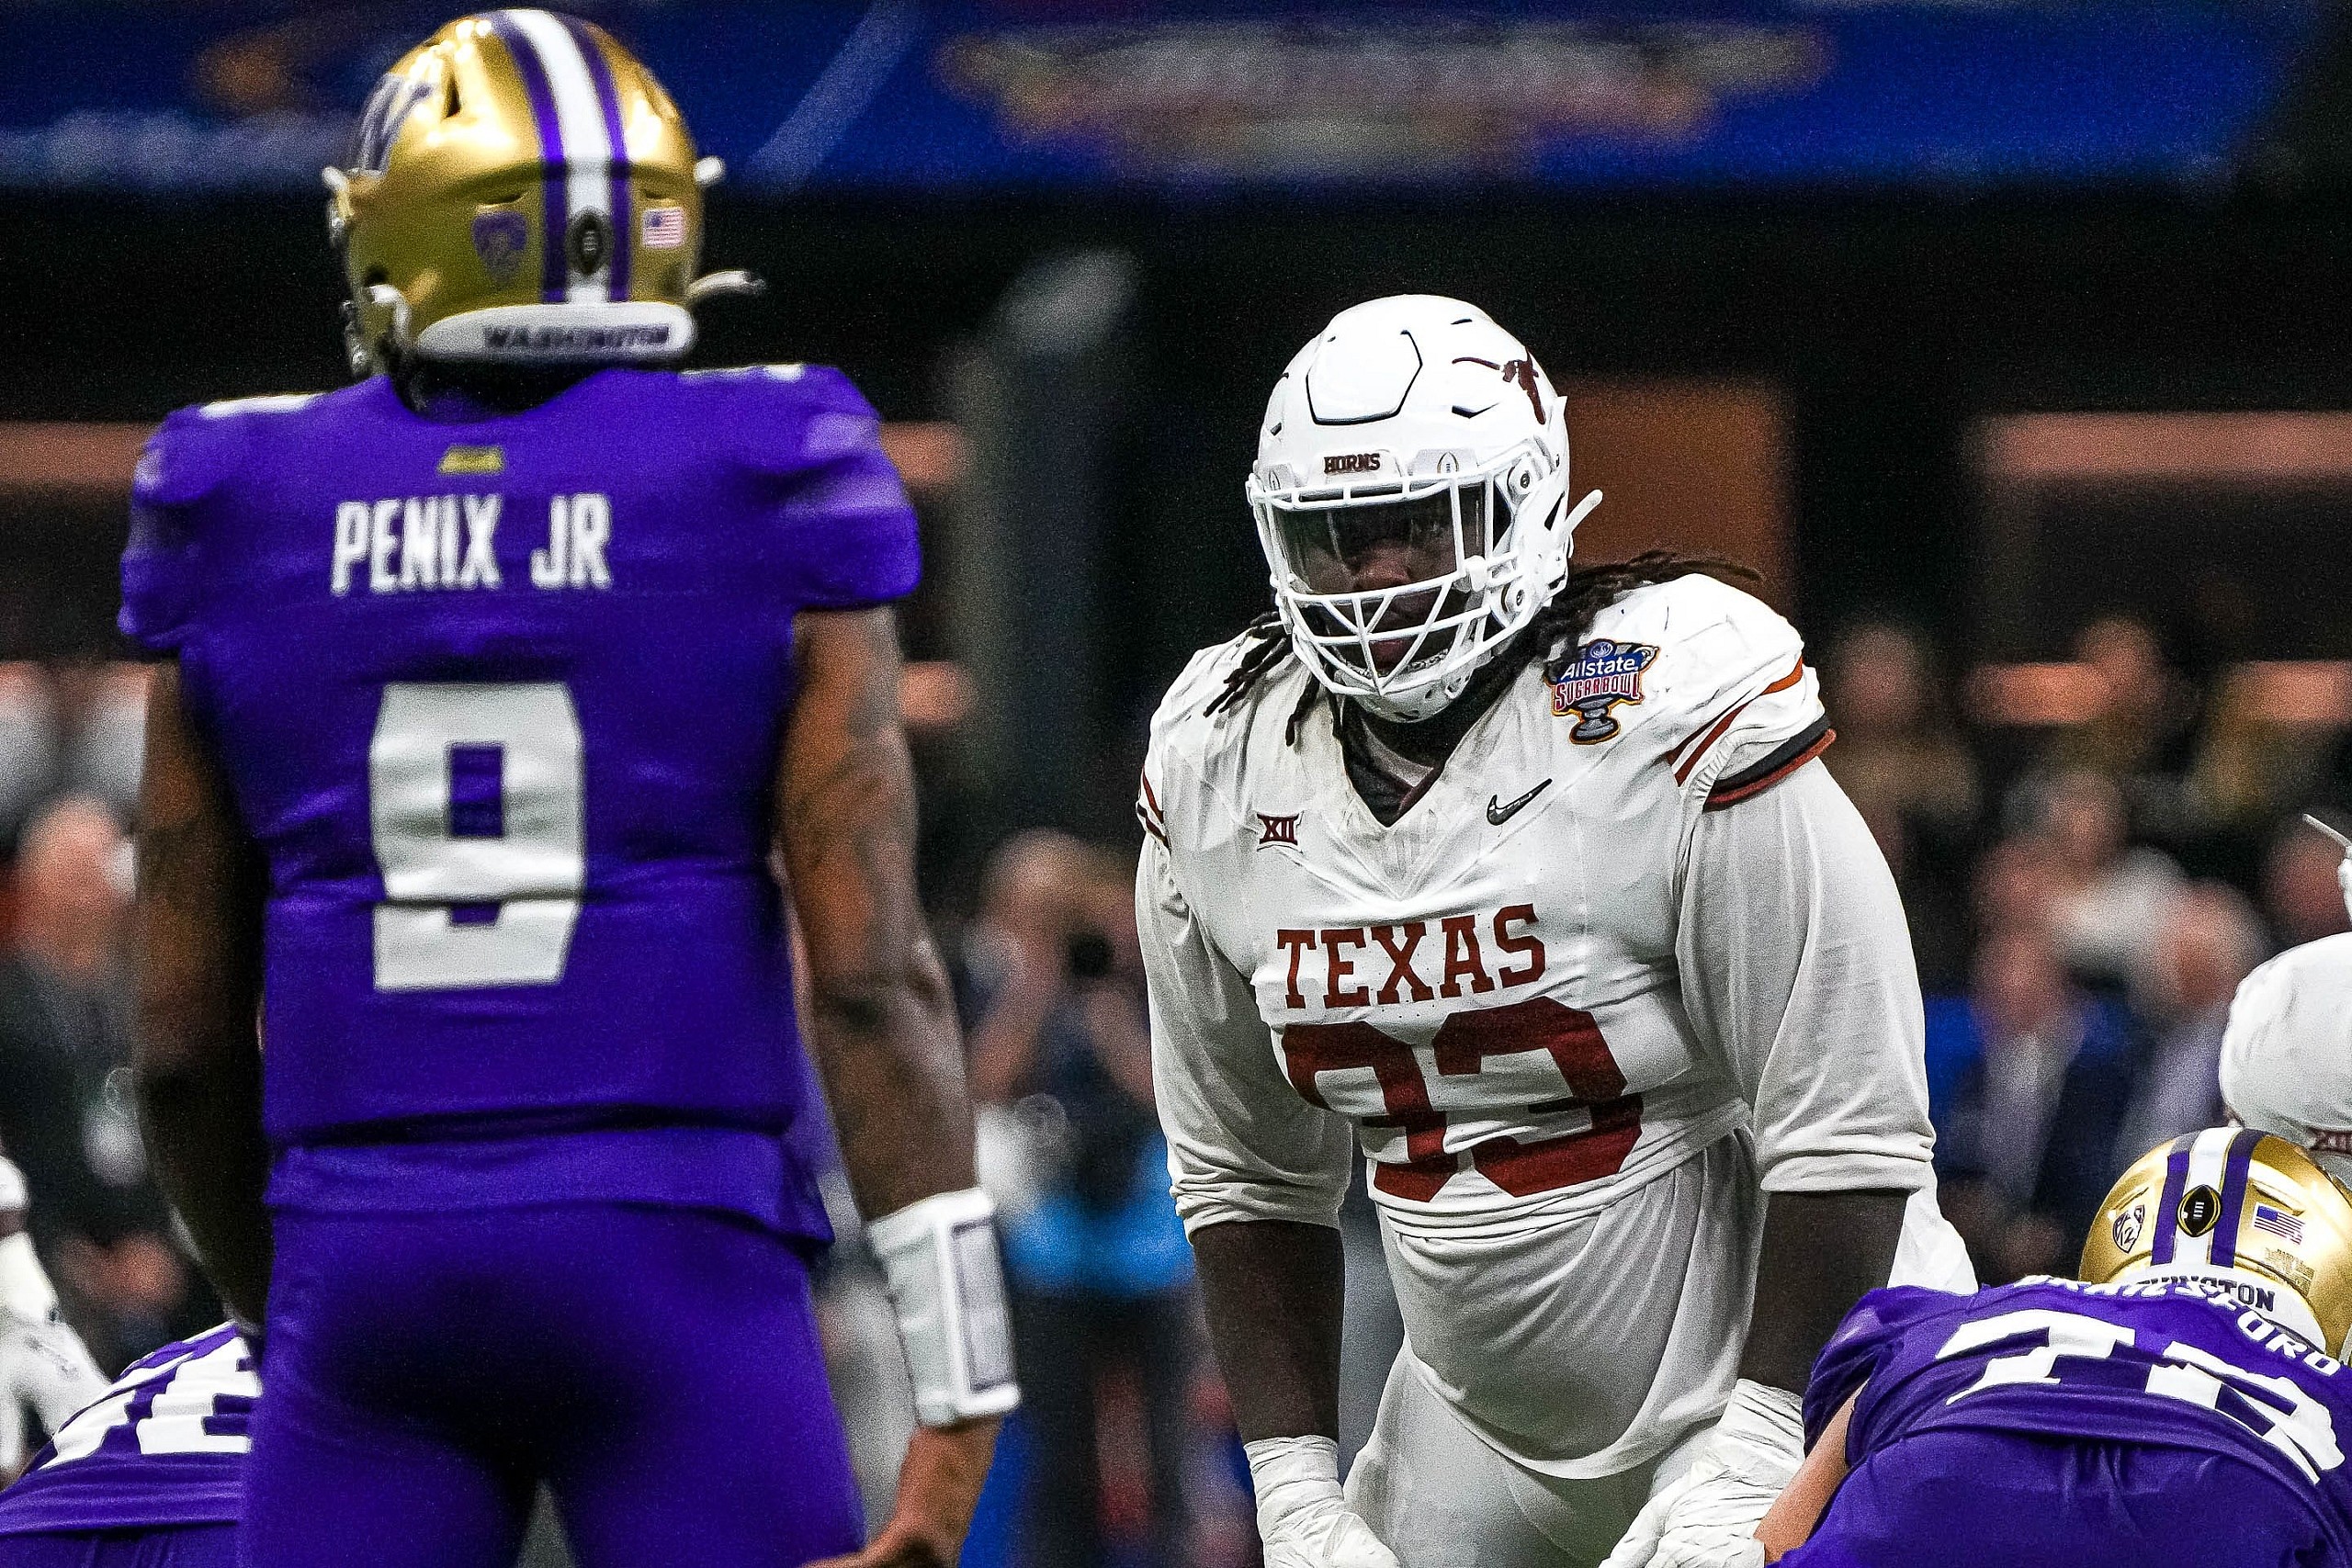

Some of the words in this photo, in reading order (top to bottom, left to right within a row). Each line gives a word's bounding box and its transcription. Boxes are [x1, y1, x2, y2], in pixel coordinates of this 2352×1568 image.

[1324, 453, 1380, 474] HORNS
[331, 494, 503, 597] PENIX
[530, 492, 613, 592] JR
[1561, 656, 1635, 681] Allstate
[369, 682, 584, 993] 9
[1257, 813, 1300, 846] XII
[1277, 904, 1546, 1010] TEXAS
[1282, 996, 1645, 1203] 93
